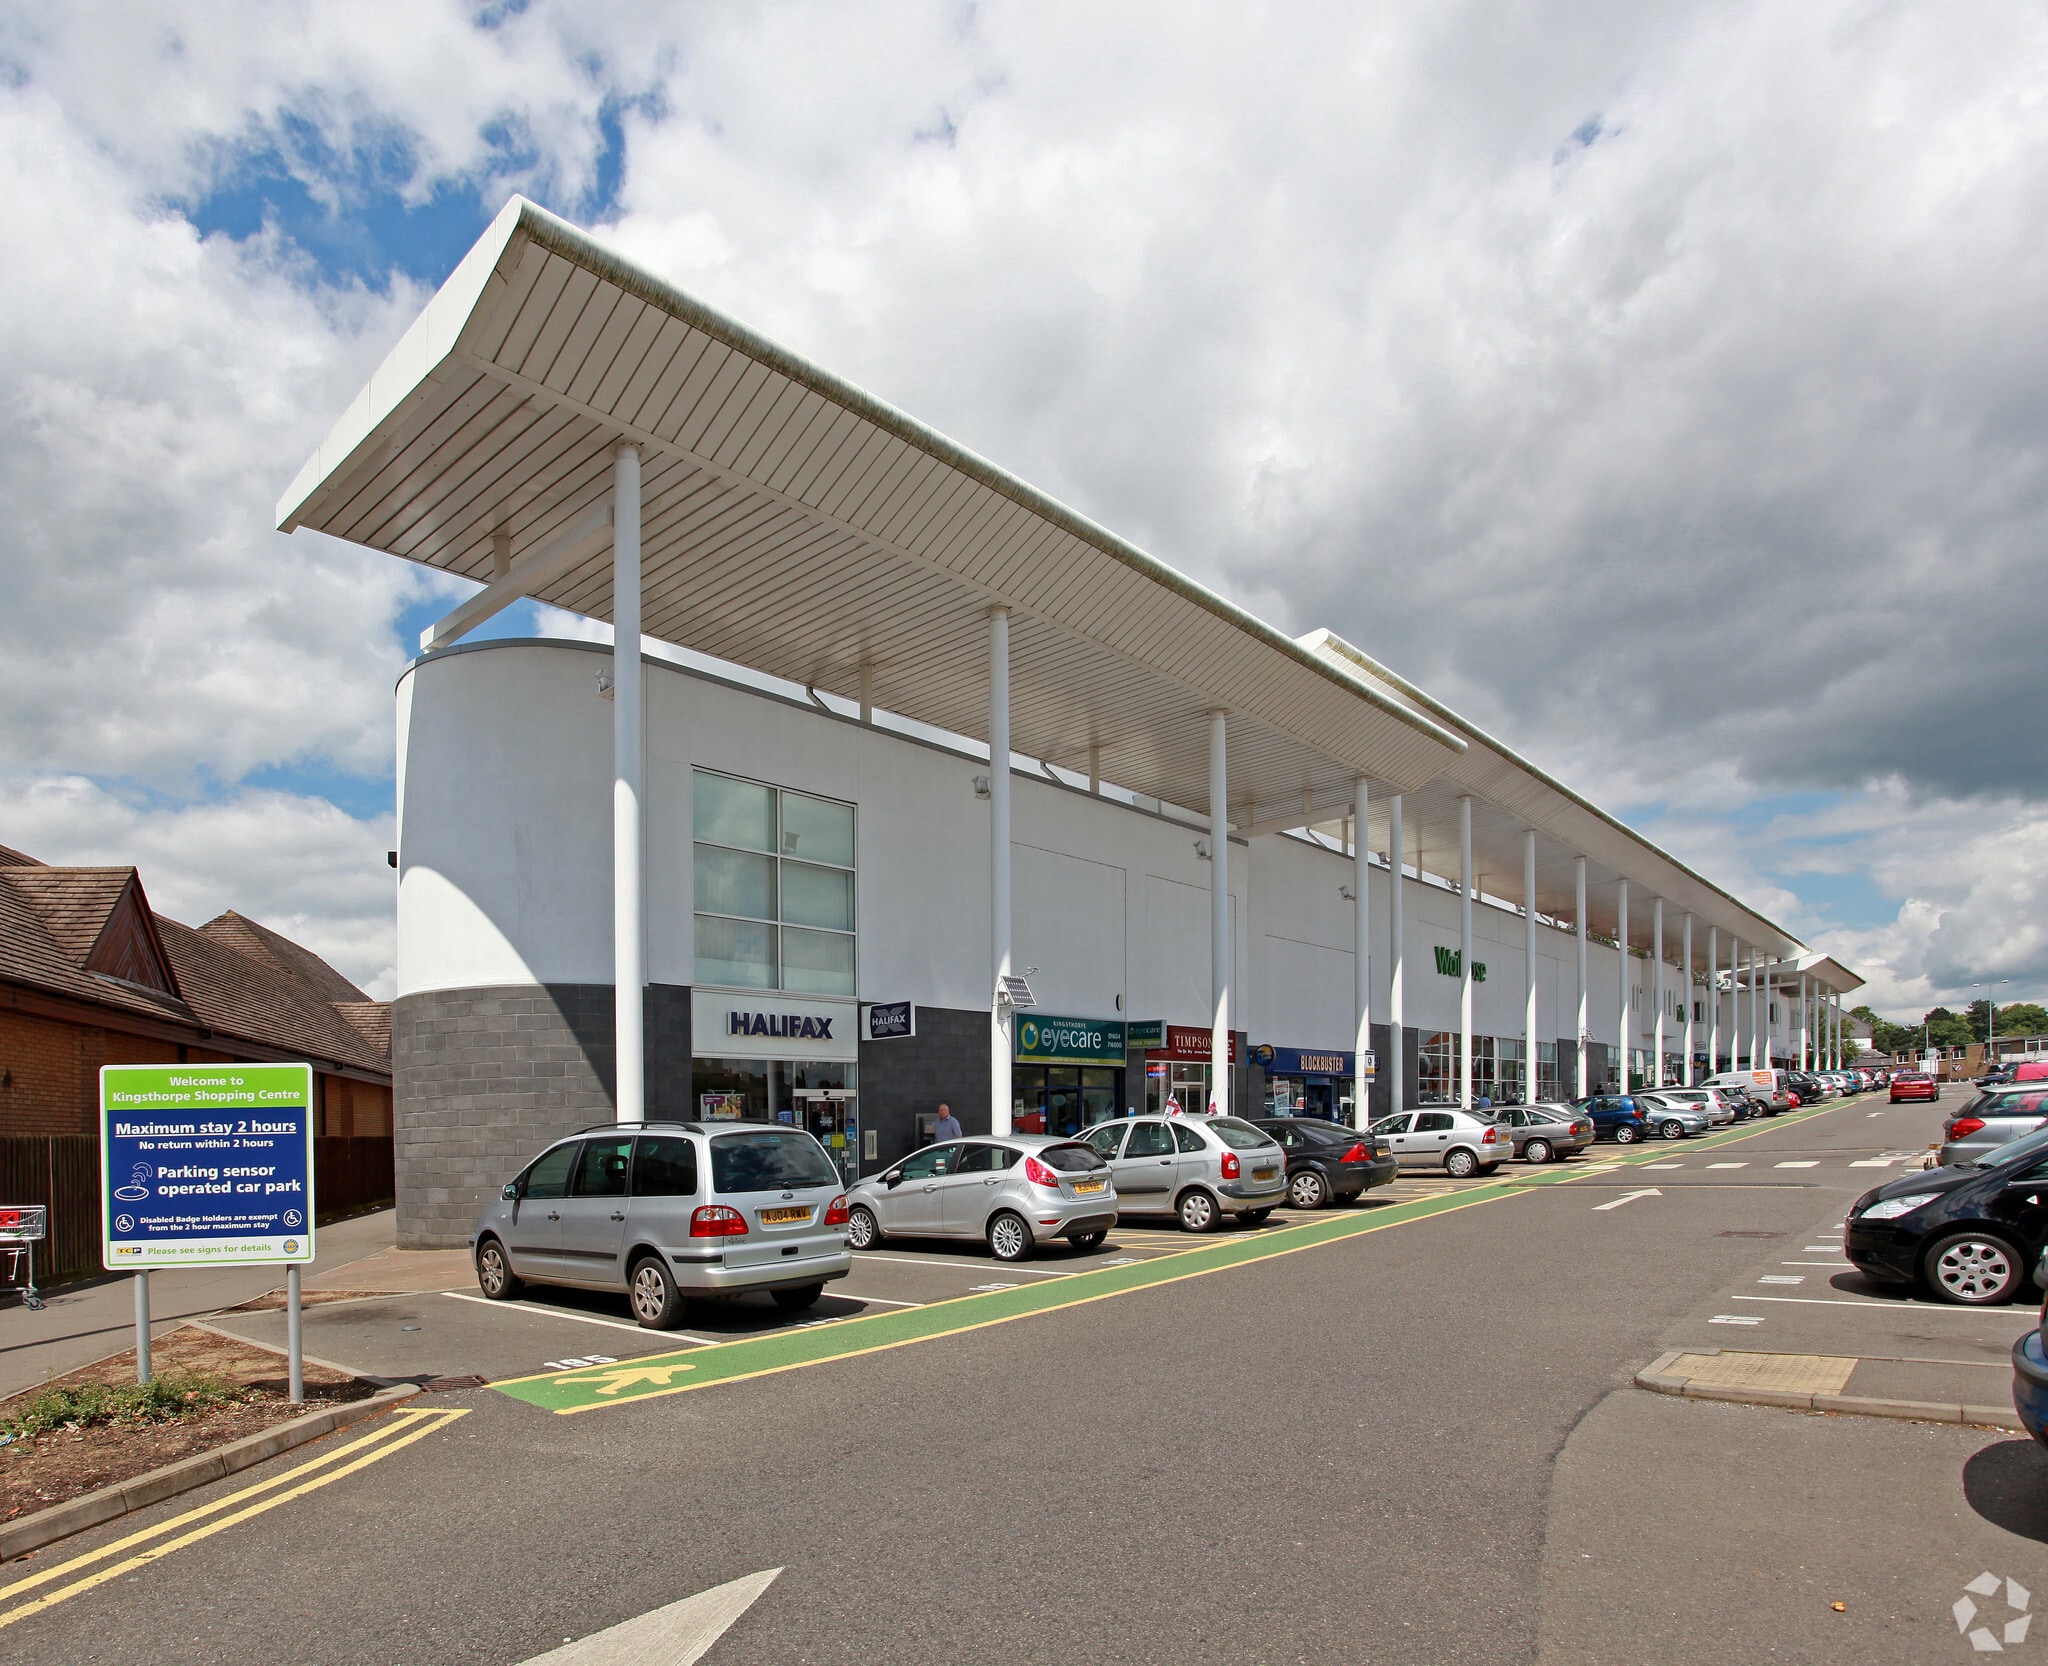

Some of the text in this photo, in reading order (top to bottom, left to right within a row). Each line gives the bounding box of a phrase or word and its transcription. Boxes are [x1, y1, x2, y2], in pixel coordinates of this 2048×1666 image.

[727, 1011, 833, 1040] HALIFAX
[872, 1014, 906, 1026] HALIFAX
[1053, 1020, 1087, 1029] KINGSTHORPE
[1041, 1027, 1102, 1053] eyecare
[1300, 1055, 1344, 1072] BLOCKBUSTER
[170, 1076, 244, 1087] Welcome to
[113, 1089, 300, 1104] Kingsthorpe Shopping Centre
[115, 1120, 297, 1136] Maximum stay 2 hours
[139, 1138, 274, 1150] No return within 2 hours
[157, 1165, 276, 1180] Parking sensor
[158, 1179, 301, 1198] operated car park
[140, 1216, 174, 1224] Disabled
[176, 1215, 201, 1225] Badge
[202, 1214, 232, 1222] Holders
[248, 1213, 278, 1223] exempt
[766, 1210, 788, 1222] AJ04
[148, 1224, 168, 1232] from
[170, 1223, 184, 1231] the
[192, 1222, 211, 1231] hour
[212, 1222, 251, 1230] maximum
[253, 1221, 270, 1230] stay
[116, 1247, 142, 1255] TCP
[147, 1244, 272, 1256] Please see signs for details
